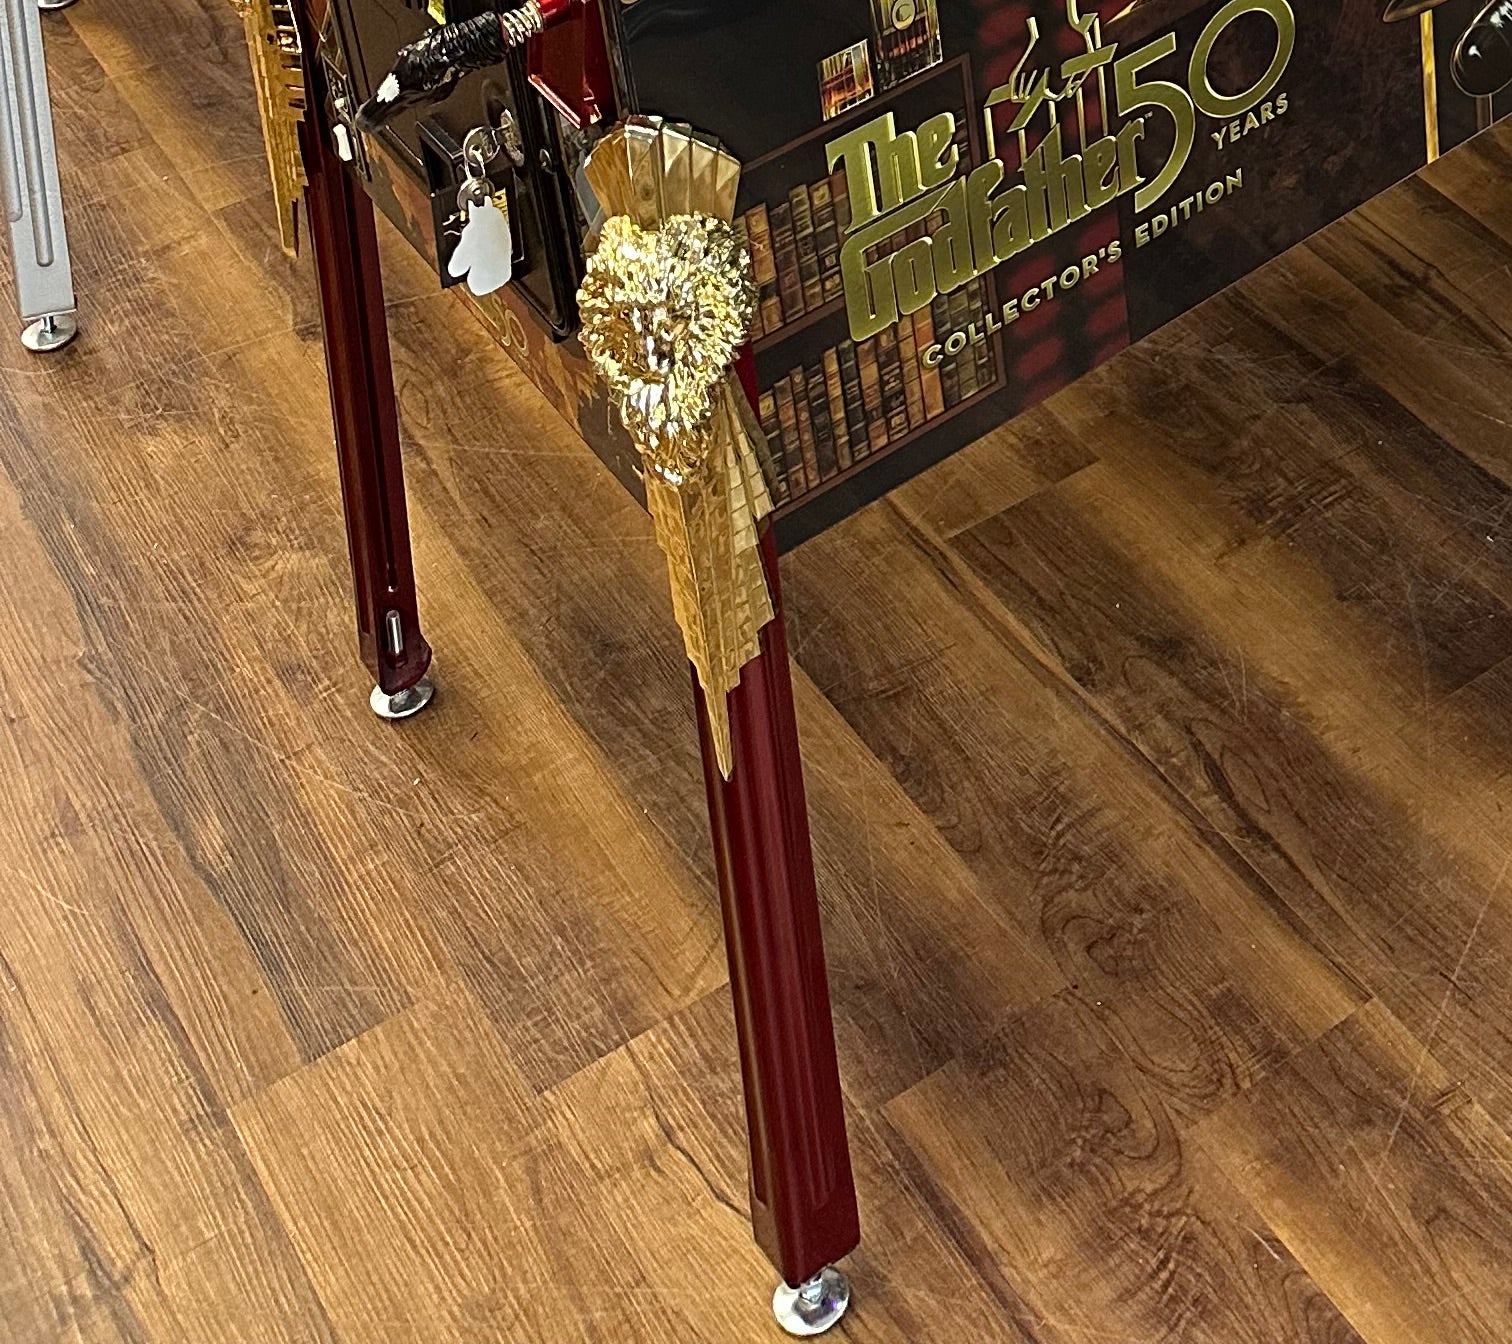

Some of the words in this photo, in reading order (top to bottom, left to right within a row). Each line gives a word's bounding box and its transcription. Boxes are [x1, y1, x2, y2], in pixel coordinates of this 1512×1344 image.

[825, 108, 959, 233] The
[1210, 91, 1288, 151] YEARS
[839, 116, 1149, 343] Godfather
[920, 234, 1122, 370] COLLECTOR'S
[1134, 166, 1246, 250] EDITION
